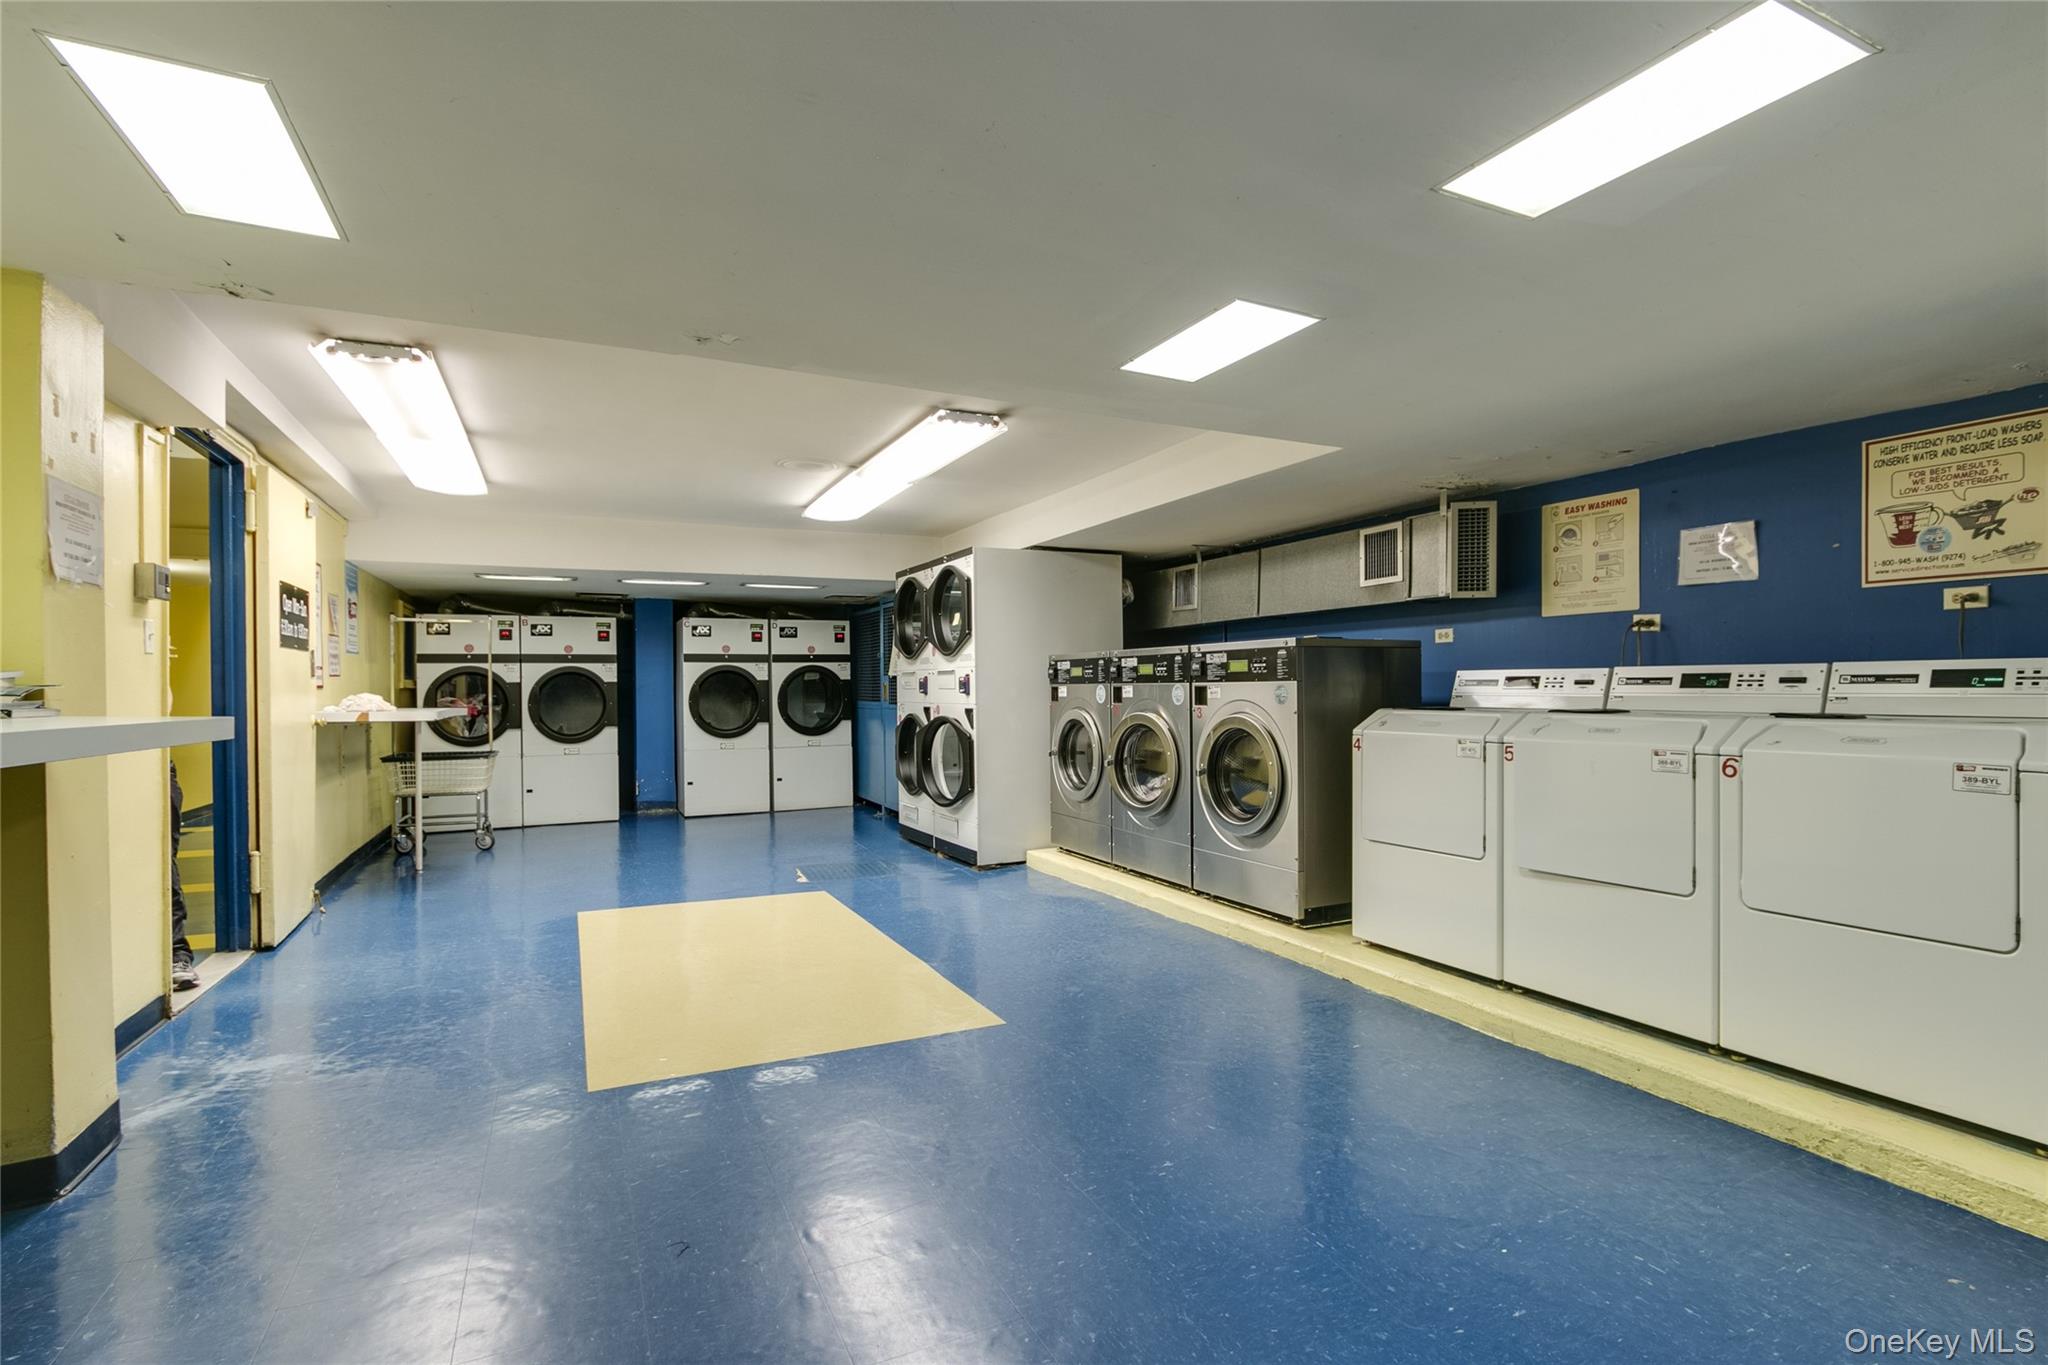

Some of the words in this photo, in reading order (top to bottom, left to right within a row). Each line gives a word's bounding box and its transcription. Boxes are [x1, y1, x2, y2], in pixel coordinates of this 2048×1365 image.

[1880, 445, 1899, 456] HIGH
[1901, 437, 1944, 453] EFFICIENCY
[1946, 427, 1998, 444] FRONT-LOAD
[2000, 419, 2043, 435] WASHERS
[1873, 454, 1910, 469] CONSERVE
[1912, 449, 1938, 462] WATER
[1941, 447, 1958, 457] AND
[1960, 440, 1996, 455] REQUIRE
[1997, 436, 2018, 449] LESS
[1908, 470, 1926, 479] FOR
[1929, 466, 1953, 475] BEST
[1912, 478, 1926, 486] WE
[1929, 468, 1989, 483] RECOMMEND
[1899, 482, 1950, 495] LOW-SUDS
[1953, 473, 2009, 488] DETERGENT
[1564, 504, 1586, 515] EASY
[1588, 497, 1628, 511] WASHING
[1941, 552, 1966, 563] (9274)
[522, 619, 529, 627] B
[684, 620, 690, 628] C
[1196, 707, 1203, 719] 3
[1353, 737, 1362, 751] 4
[1504, 745, 1514, 762] 5
[1721, 757, 1740, 778] 6
[1961, 775, 2002, 786] 389-BYL
